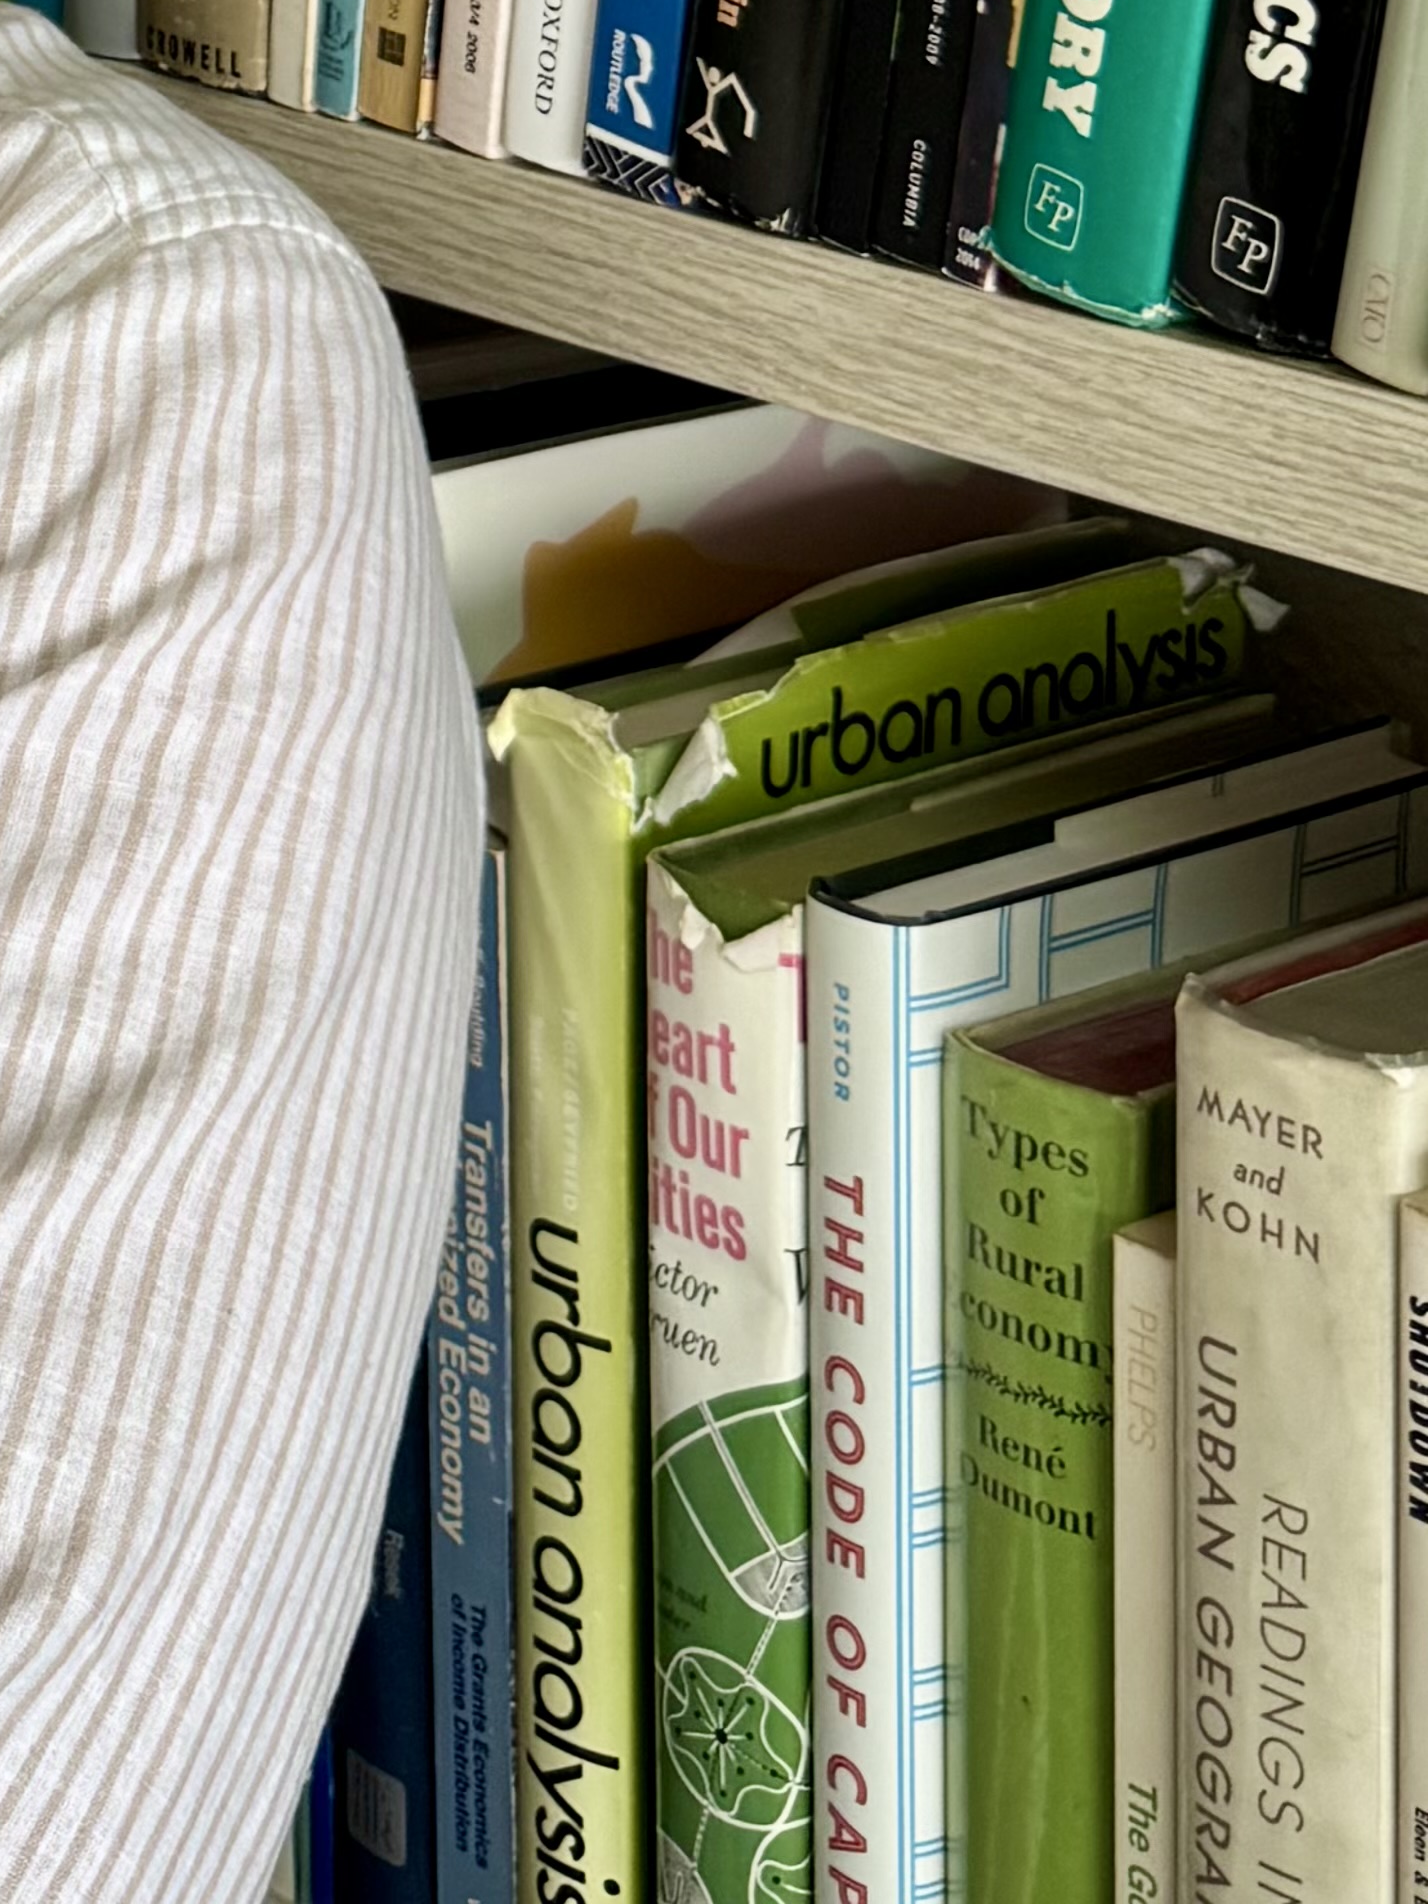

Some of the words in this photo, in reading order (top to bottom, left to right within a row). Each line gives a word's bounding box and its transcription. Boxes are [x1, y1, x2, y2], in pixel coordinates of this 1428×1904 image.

[147, 26, 242, 77] CROWELL
[1036, 184, 1076, 230] FP
[1221, 219, 1272, 275] FP
[759, 685, 961, 799] urban
[978, 608, 1229, 739] analysis
[832, 982, 853, 1102] PISTOR
[961, 1095, 1091, 1179] Types
[1196, 1087, 1326, 1161] MAYER
[999, 1184, 1046, 1228] of
[1233, 1160, 1287, 1198] and
[824, 1176, 865, 1324] THE
[966, 1220, 1086, 1304] Rural
[1196, 1188, 1322, 1265] KOHN
[529, 1218, 612, 1517] urban
[824, 1355, 865, 1578] CODE
[1197, 1335, 1239, 1572] URBAN
[826, 1614, 866, 1727] OF
[1258, 1491, 1311, 1833] READINGS
